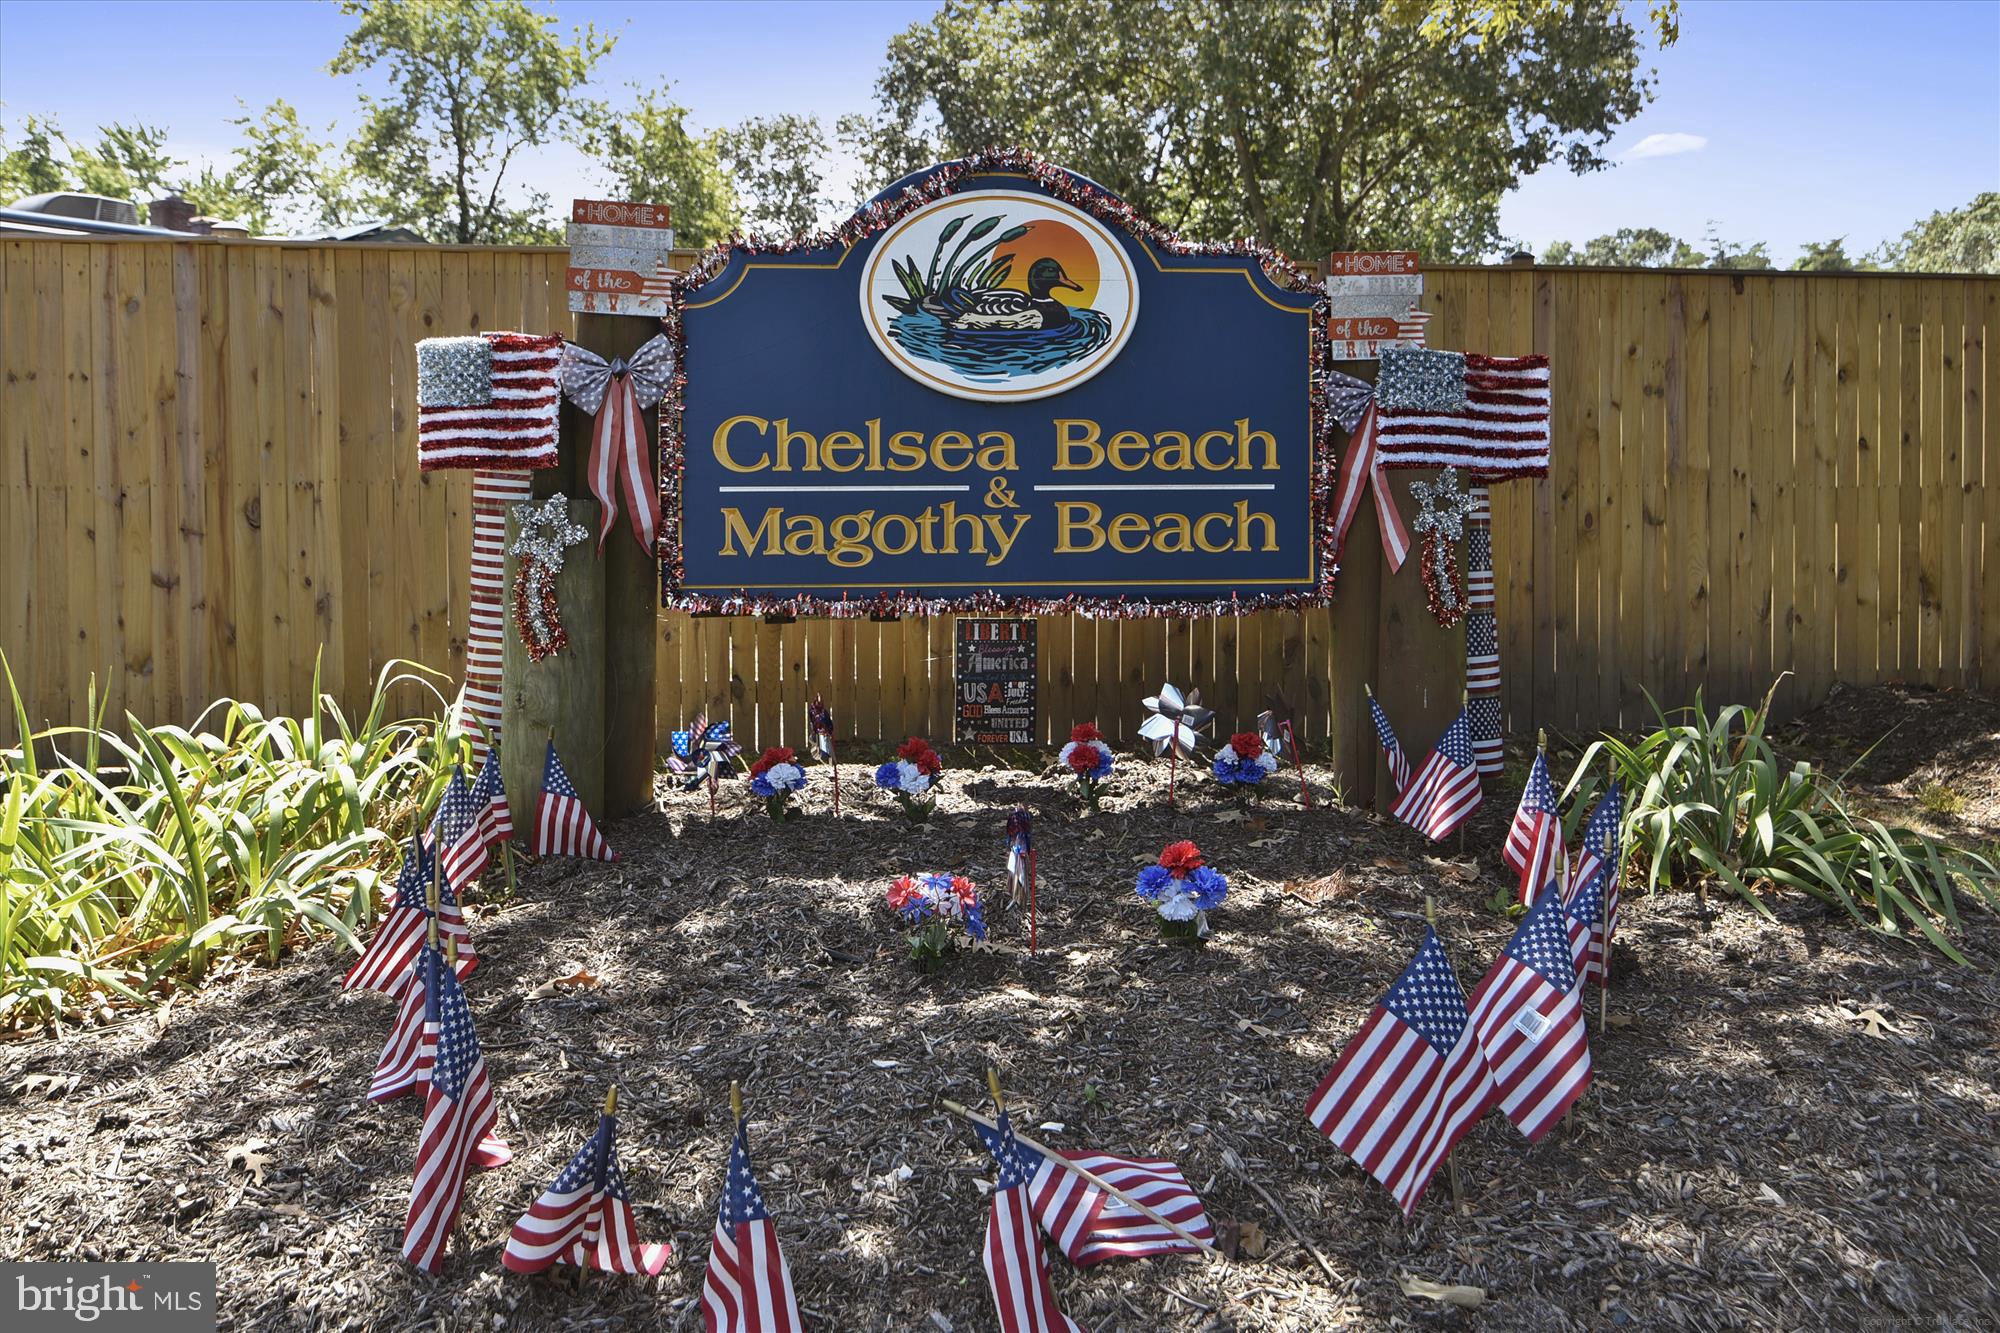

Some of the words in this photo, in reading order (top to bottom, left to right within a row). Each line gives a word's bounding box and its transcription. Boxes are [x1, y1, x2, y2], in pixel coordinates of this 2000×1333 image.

[587, 203, 654, 225] HOME
[1345, 254, 1406, 272] HOME
[574, 270, 591, 290] of
[597, 271, 631, 289] the
[1336, 319, 1351, 339] of
[1357, 320, 1388, 336] the
[712, 414, 1020, 474] Chelsea
[1052, 417, 1281, 472] Beach
[983, 475, 1021, 509] &
[718, 500, 1031, 568] Magothy
[1053, 499, 1280, 554] Beach
[965, 623, 1027, 641] LIBERTY
[964, 652, 1028, 673] America
[963, 682, 1004, 703] USA
[1007, 687, 1026, 697] JULY
[962, 704, 983, 717] GOD
[991, 718, 1029, 729] UNITED
[977, 733, 1009, 743] FOREVER
[1009, 731, 1028, 743] USA
